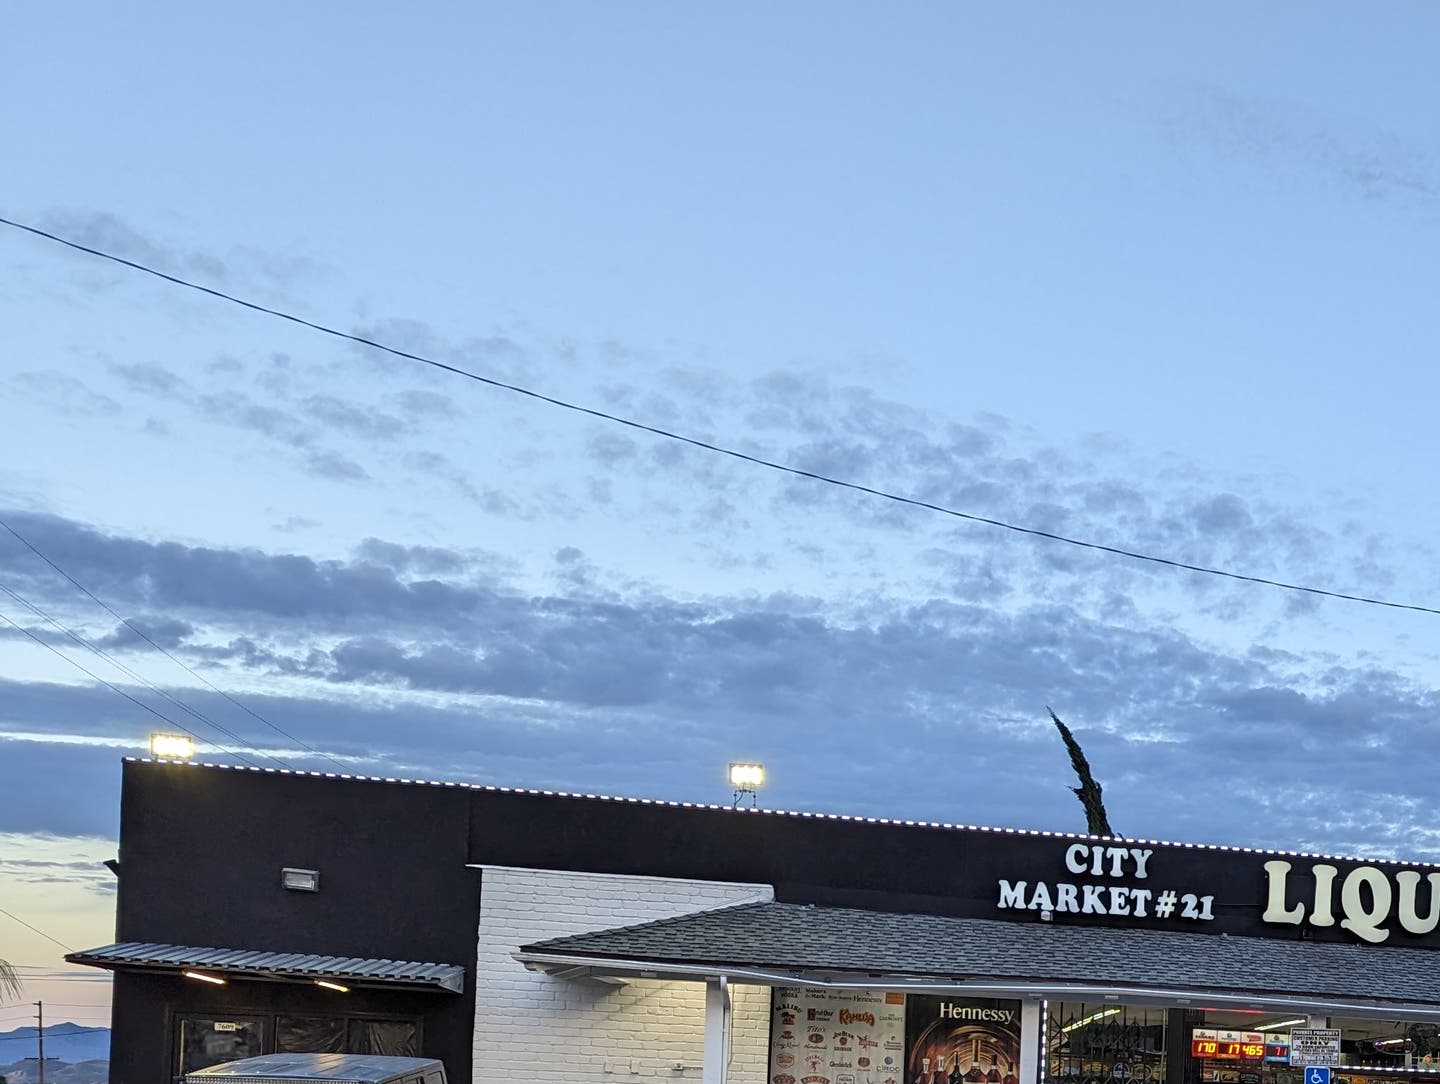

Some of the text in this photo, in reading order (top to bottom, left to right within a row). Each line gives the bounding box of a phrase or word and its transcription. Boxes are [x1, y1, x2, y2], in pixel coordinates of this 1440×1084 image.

[1065, 843, 1153, 879] CITY
[940, 1002, 1014, 1025] Hennessy
[1197, 1042, 1217, 1054] 170
[1228, 1044, 1241, 1055] 17
[1242, 1045, 1264, 1057] 465
